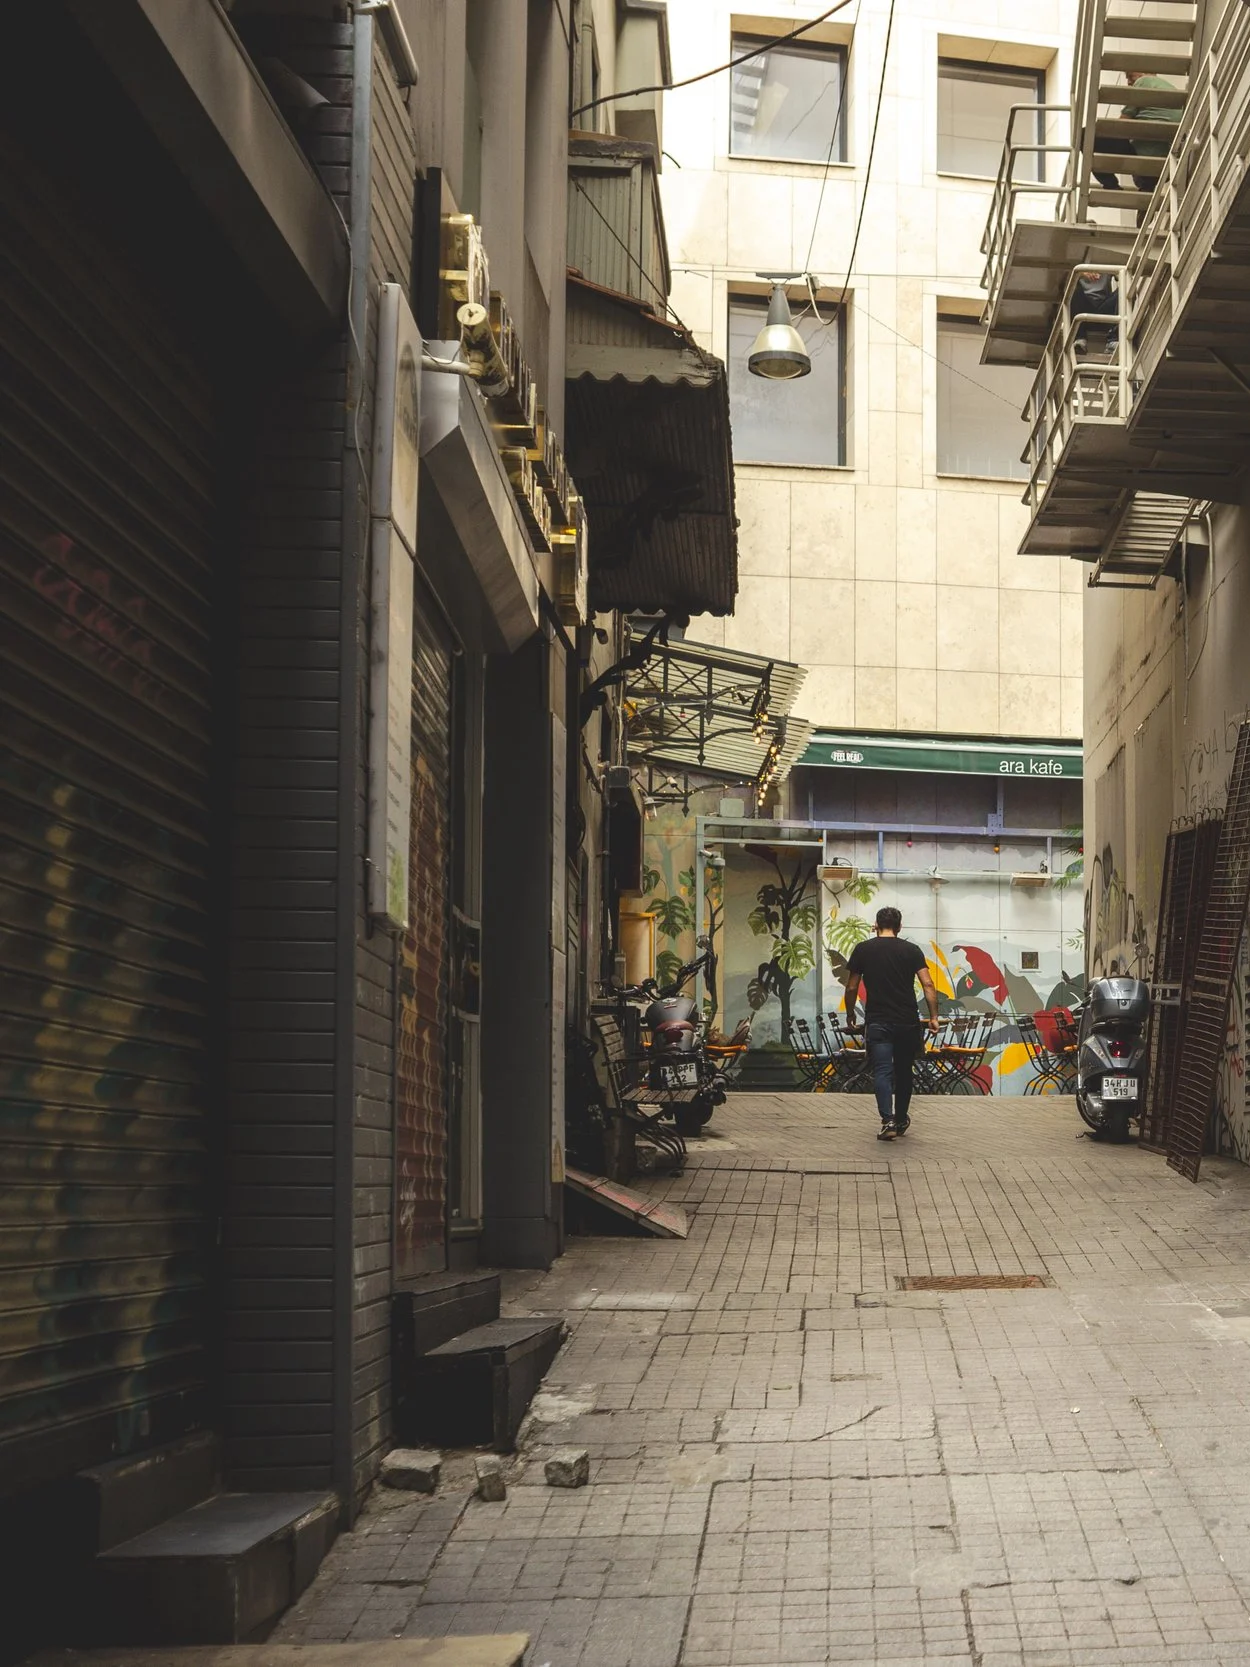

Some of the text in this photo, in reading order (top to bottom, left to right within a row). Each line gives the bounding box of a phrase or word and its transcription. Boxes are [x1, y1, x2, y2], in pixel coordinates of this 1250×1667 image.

[999, 758, 1063, 775] ara kafe
[1113, 1088, 1129, 1096] 519
